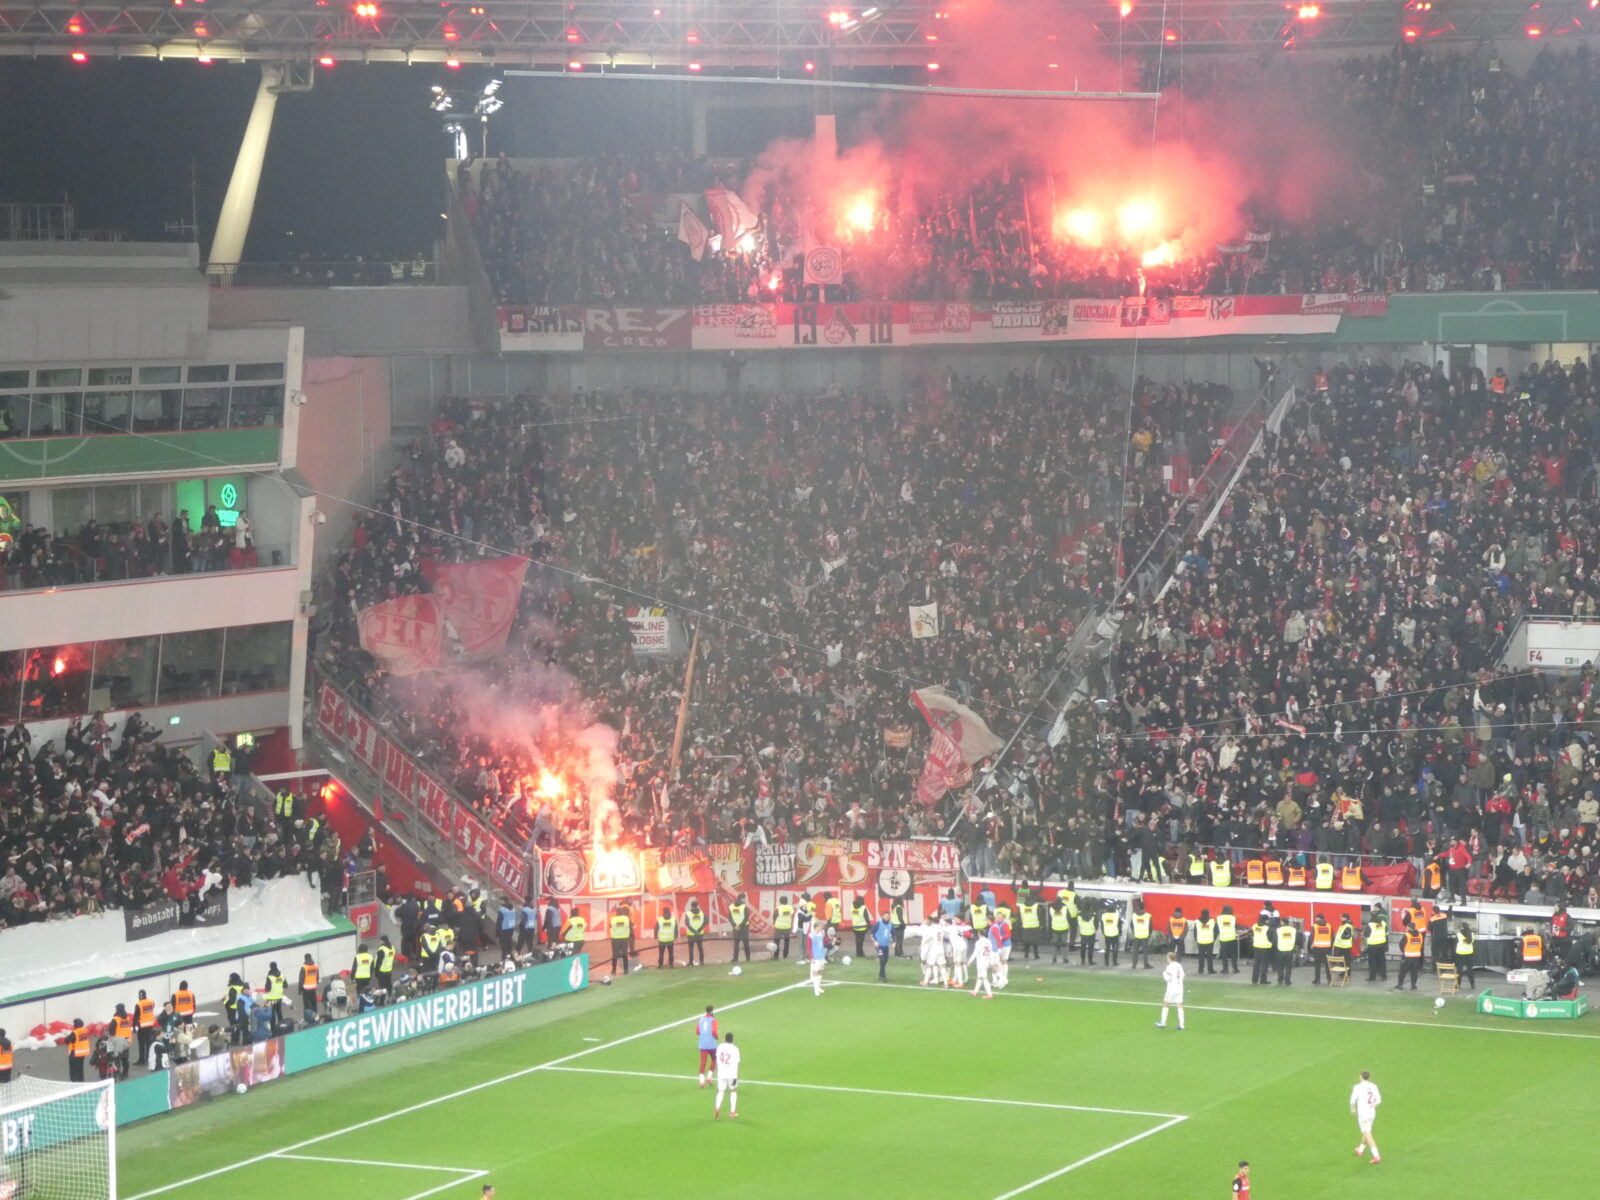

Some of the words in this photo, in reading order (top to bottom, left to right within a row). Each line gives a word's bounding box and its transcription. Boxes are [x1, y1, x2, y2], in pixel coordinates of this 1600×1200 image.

[603, 336, 668, 346] CREW
[1529, 650, 1543, 663] F4
[756, 854, 796, 872] STADT
[325, 973, 527, 1059] #GEWINNERBLEIBT
[719, 1051, 732, 1065] 42
[1367, 1091, 1374, 1105] 2
